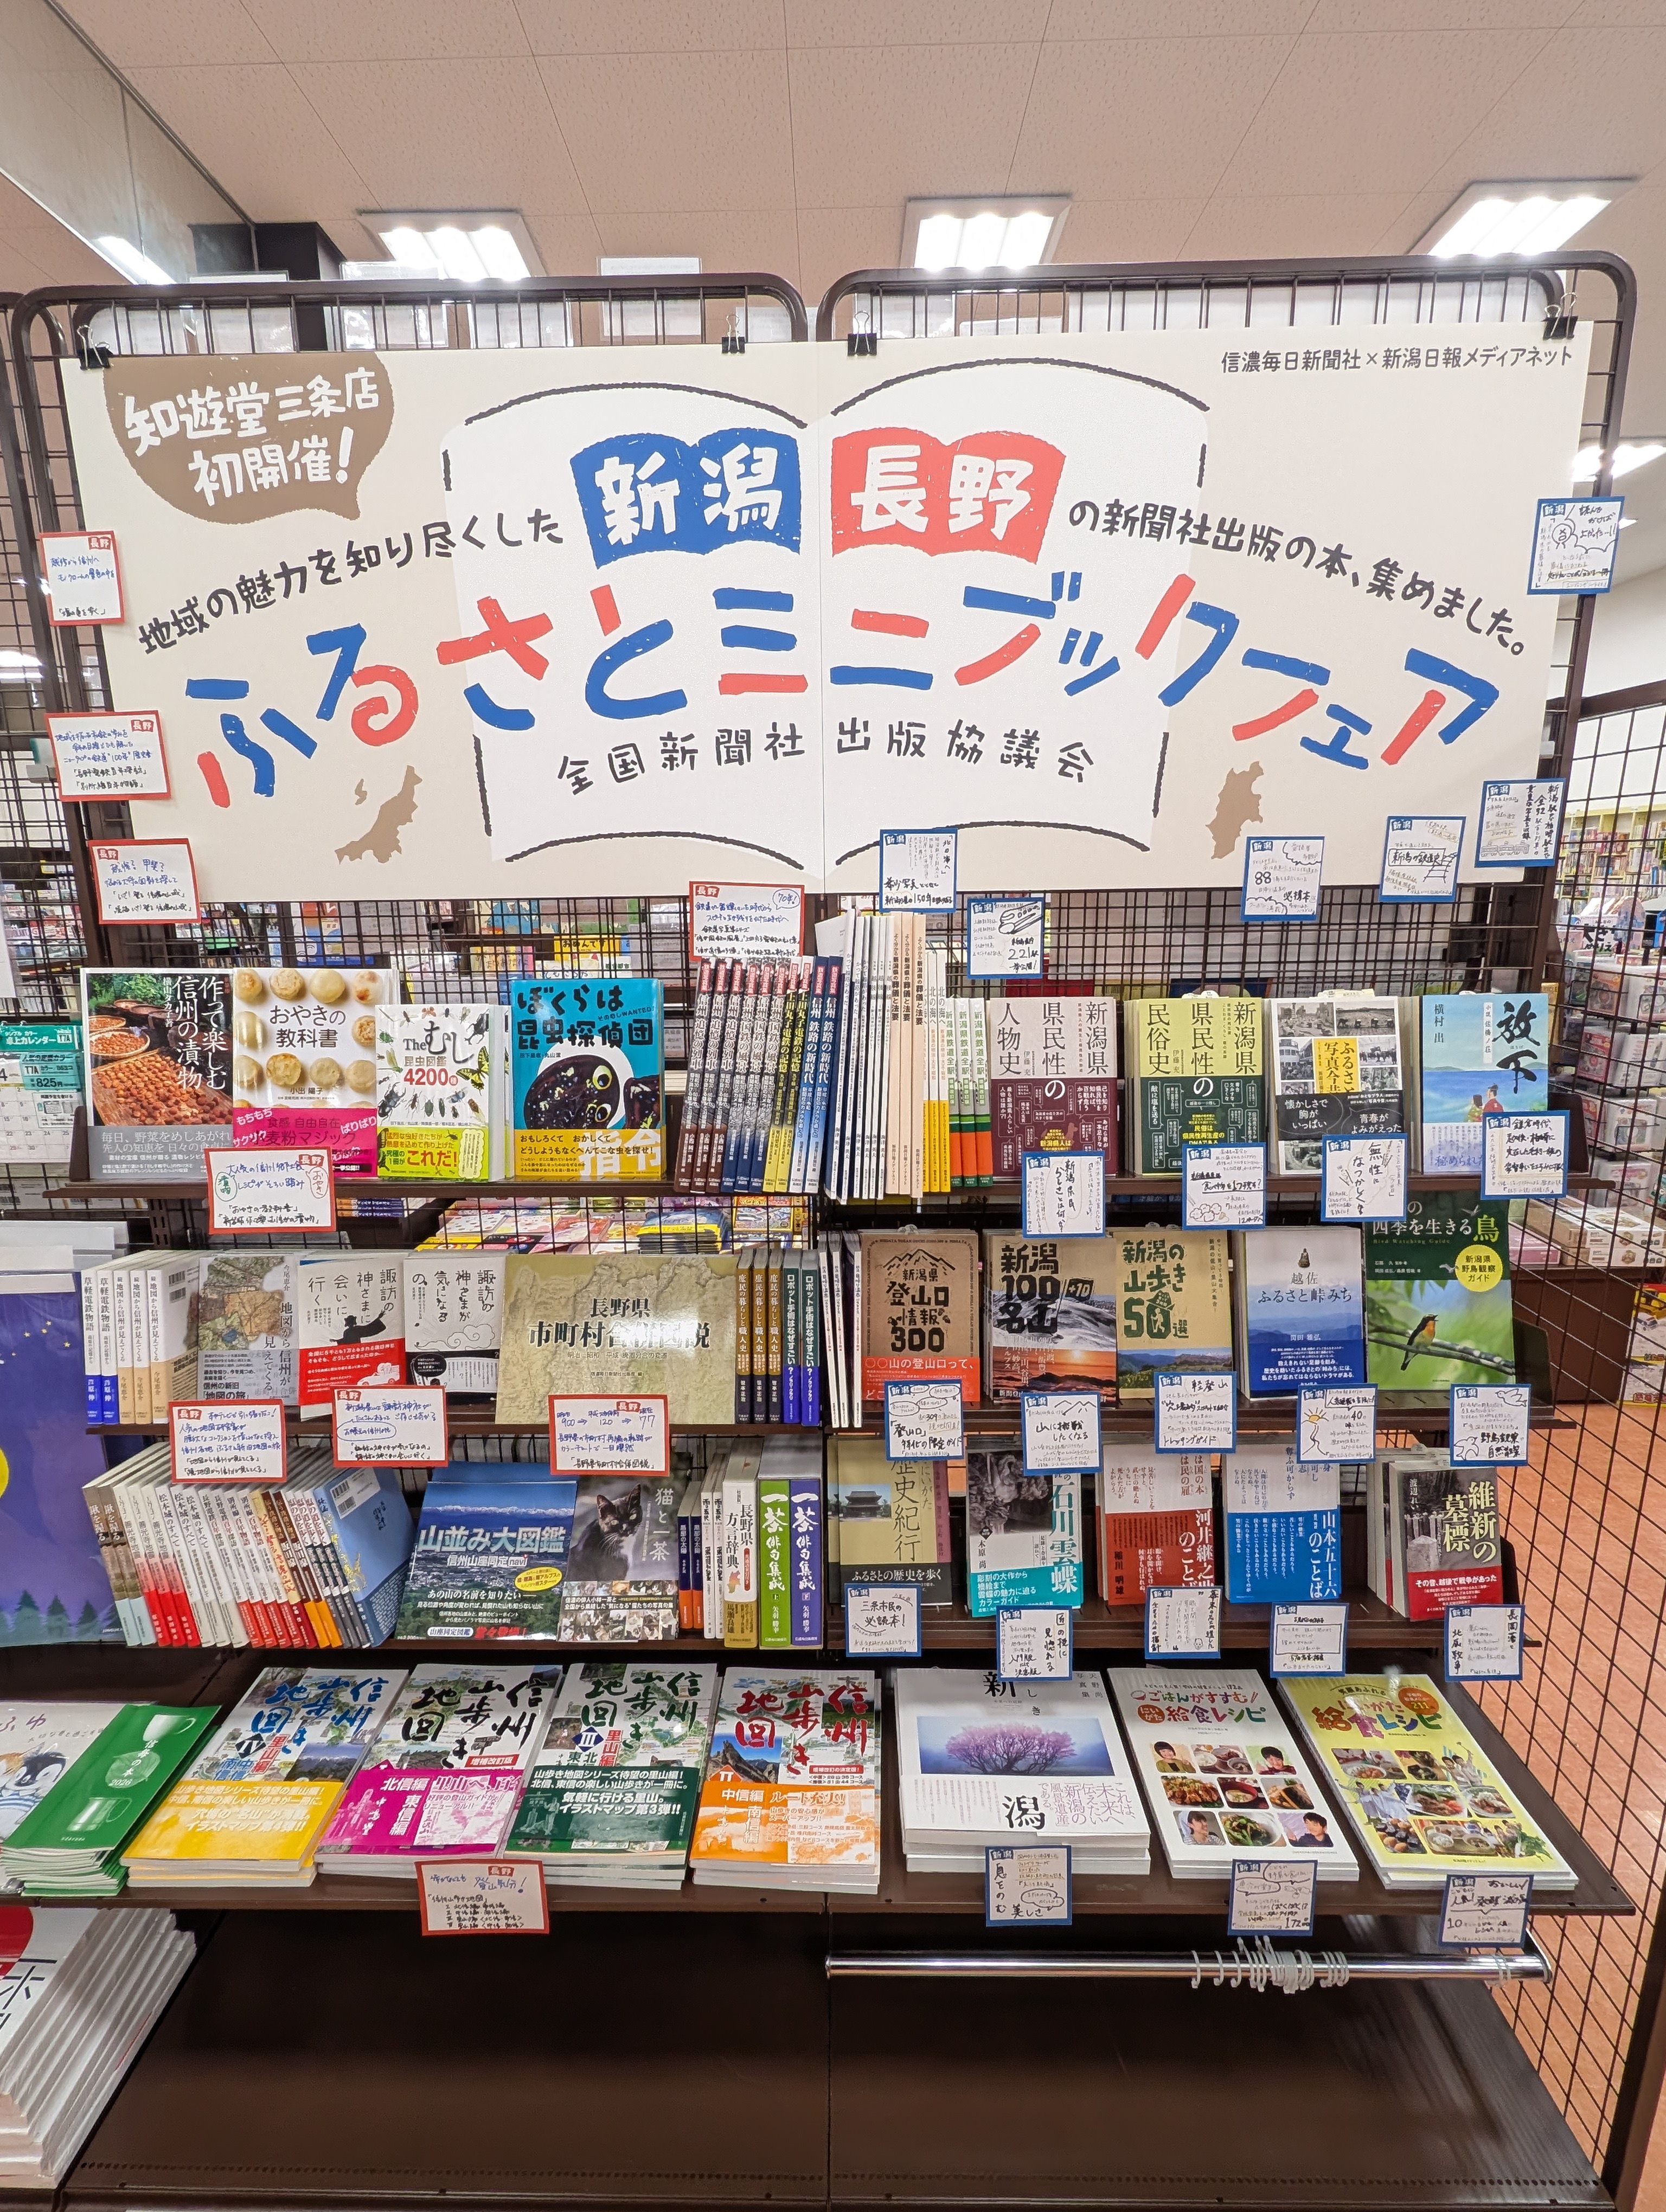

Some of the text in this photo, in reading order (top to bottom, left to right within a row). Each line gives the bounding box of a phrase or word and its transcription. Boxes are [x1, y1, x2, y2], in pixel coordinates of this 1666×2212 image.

[1221, 346, 1572, 374] 信濃毎日新聞社×新潟日報メディアネット
[124, 366, 379, 456] 知遊堂三条店
[188, 427, 354, 506] 初開催!
[594, 442, 783, 545] 新潟
[850, 444, 1034, 541] 長野
[90, 537, 110, 549] 長野
[139, 509, 563, 654] 地域の魅力を知り尽くした
[1069, 498, 1524, 656] の新聞社出版の本、集めました。
[185, 570, 1500, 808] ふるさとミニブックフェア
[1490, 786, 1509, 795] 新潟
[98, 848, 117, 859] 長野
[887, 835, 905, 845] 新潟
[975, 903, 994, 913] 新潟
[517, 983, 624, 1015] ぼくらは
[270, 1005, 347, 1027] おやきの
[175, 975, 204, 1091] 信州の漬物
[200, 975, 229, 1091] 作って楽しむ
[275, 1029, 339, 1049] 教科書
[402, 1020, 475, 1064] The むし
[517, 1017, 654, 1050] 昆虫探偵団
[997, 1002, 1022, 1076] 人物史
[1085, 1001, 1109, 1075] 新潟県
[1146, 1003, 1171, 1075] 民俗史
[1234, 1001, 1257, 1075] 新潟県
[1493, 999, 1541, 1095] 放下
[404, 1056, 447, 1067] 昆虫図鑑
[1042, 1002, 1066, 1099] 県民性の
[1191, 1002, 1214, 1097] 県民性の
[236, 1108, 273, 1126] もちもち
[1285, 1099, 1329, 1110] 懐かしさで
[1299, 1110, 1319, 1120] 胸が
[294, 1117, 341, 1129] 自由自在
[1292, 1120, 1328, 1129] いっぱい
[1351, 1124, 1402, 1134] よみがえった
[1360, 1114, 1389, 1124] 青春が
[520, 1134, 611, 1143] おもしろくて おかしくて
[1329, 1142, 1350, 1152] 新潟
[406, 1149, 458, 1168] これだ!
[1029, 1157, 1050, 1168] 新潟
[1001, 1242, 1059, 1275] 新潟
[1122, 1239, 1185, 1265] 新潟の
[1464, 1255, 1491, 1264] 新潟県
[902, 1268, 939, 1282] 新潟県
[1123, 1265, 1186, 1294] 山歩き
[1291, 1271, 1318, 1285] 越佐
[1461, 1265, 1497, 1275] 野鳥観察
[1468, 1274, 1490, 1283] ガイド
[308, 1276, 326, 1306] 行く
[334, 1275, 349, 1316] 会いに
[379, 1268, 398, 1312] 諏訪の
[434, 1270, 450, 1322] 気になる
[456, 1270, 471, 1322] 神さまが
[477, 1269, 496, 1313] 諏訪の
[886, 1281, 949, 1307] 登山口
[1001, 1274, 1061, 1302] 100
[1258, 1287, 1353, 1304] ふるさと峠みち
[590, 1297, 651, 1319] 長野県
[739, 1274, 747, 1352] 庶民の暮らしと職人史
[754, 1274, 764, 1352] 庶民の暮らしと職人史
[770, 1274, 779, 1352] 庶民の暮らしと職人史
[902, 1307, 940, 1326] 情報
[997, 1302, 1058, 1334] 名山
[279, 1301, 293, 1386] 地図から信州が
[890, 1327, 945, 1353] 300
[1172, 1321, 1189, 1339] 選
[203, 1382, 240, 1390] 信州の新旧
[1304, 1390, 1325, 1399] 新潟
[180, 1410, 200, 1419] 長野
[618, 1402, 639, 1411] 長野
[1027, 1396, 1047, 1406] 新潟
[639, 1414, 656, 1430] 77
[158, 1493, 181, 1547] 松本城のすべて
[174, 1493, 195, 1546] 松本城のすべて
[186, 1495, 209, 1548] 松本城のすべて
[649, 1487, 674, 1562] 猫と一茶
[740, 1504, 754, 1547] 長野県
[1441, 1494, 1470, 1554] 墓標
[1468, 1480, 1497, 1563] 維新の
[416, 1525, 566, 1553] 山並み大図鑑
[725, 1513, 740, 1570] 方言辞典
[1049, 1481, 1079, 1594] 石川雲蝶
[1309, 1532, 1323, 1598] のことば
[1322, 1511, 1337, 1597] 山本五十六
[852, 1570, 941, 1581] ふるさとの歴史を歩く
[977, 1571, 1028, 1583] 彫刻の大作から
[851, 1589, 869, 1597] 新潟
[860, 1600, 902, 1613] 三条市民の
[979, 1597, 1019, 1607] カラーガイド
[864, 1613, 906, 1628] 必読本!
[1451, 1609, 1471, 1617] 新潟
[430, 1628, 471, 1636] 山座同定図鑑
[401, 1687, 459, 1743] 地図
[491, 1676, 549, 1750] 信州
[582, 1679, 628, 1726] 地図
[659, 1671, 703, 1731] 信州
[1165, 1705, 1267, 1724] 給食レシピ
[734, 1690, 785, 1748] 地図
[785, 1683, 825, 1776] 山歩き
[824, 1684, 870, 1757] 信州
[110, 1778, 132, 1786] 2026
[381, 1776, 427, 1791] 北信編
[530, 1780, 688, 1790] 北信、東信の楽しい山歩きが一冊に。
[534, 1770, 684, 1780] 山歩き地図シリーズ待望の里山編!
[559, 1804, 681, 1815] イラストマップ第3弾!!
[561, 1792, 664, 1804] 気軽に行ける里山。
[721, 1788, 765, 1803] 中信編
[389, 1794, 421, 1836] 東信編
[742, 1805, 762, 1844] 南信編
[1002, 1795, 1047, 1830] 潟
[992, 1850, 1013, 1859] 新潟
[994, 1862, 1007, 1914] 息をのむ
[1011, 1903, 1043, 1919] 美しさ
